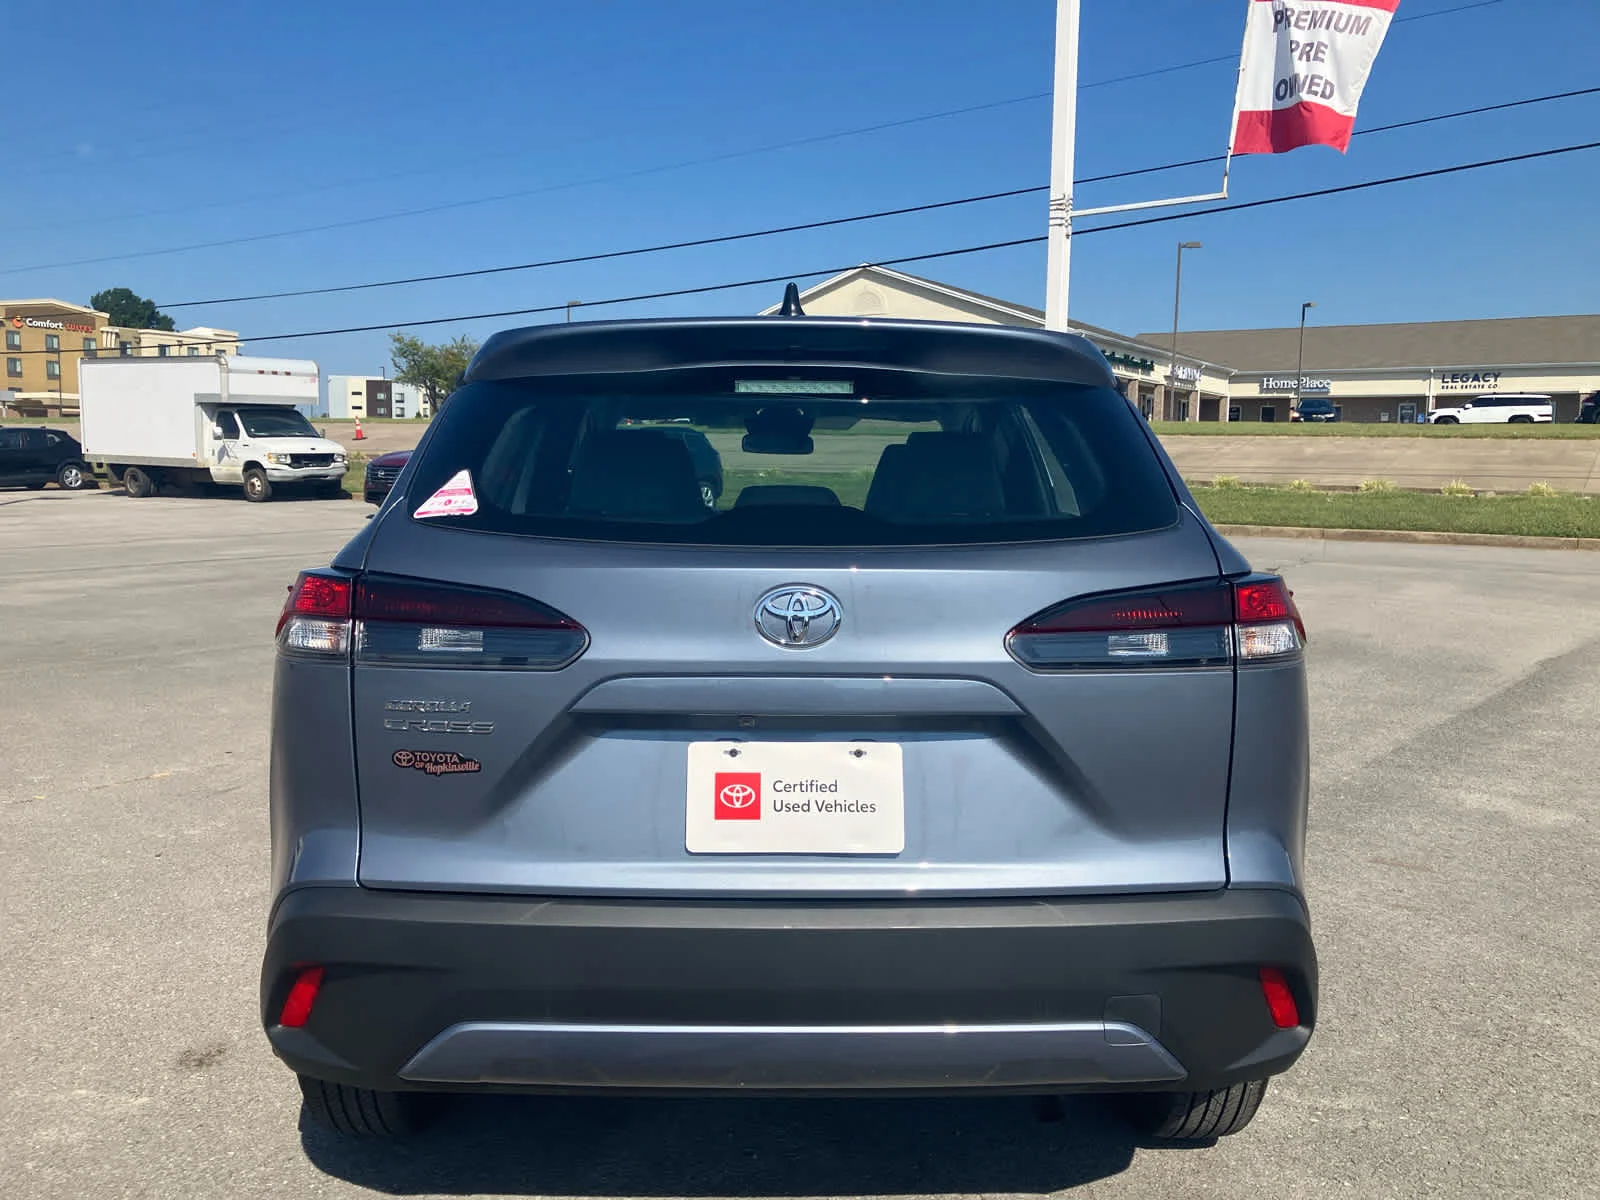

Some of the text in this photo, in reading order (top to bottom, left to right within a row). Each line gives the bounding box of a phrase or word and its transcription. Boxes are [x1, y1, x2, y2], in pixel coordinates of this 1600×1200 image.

[1272, 7, 1373, 36] PREMIUM
[1289, 39, 1329, 63] PRE
[25, 317, 64, 330] Comfort
[1441, 372, 1502, 384] LEGACY
[384, 719, 497, 734] CROSS
[414, 751, 460, 763] TOYOTA
[772, 779, 838, 793] Certified
[772, 799, 877, 813] Used Vehicles
